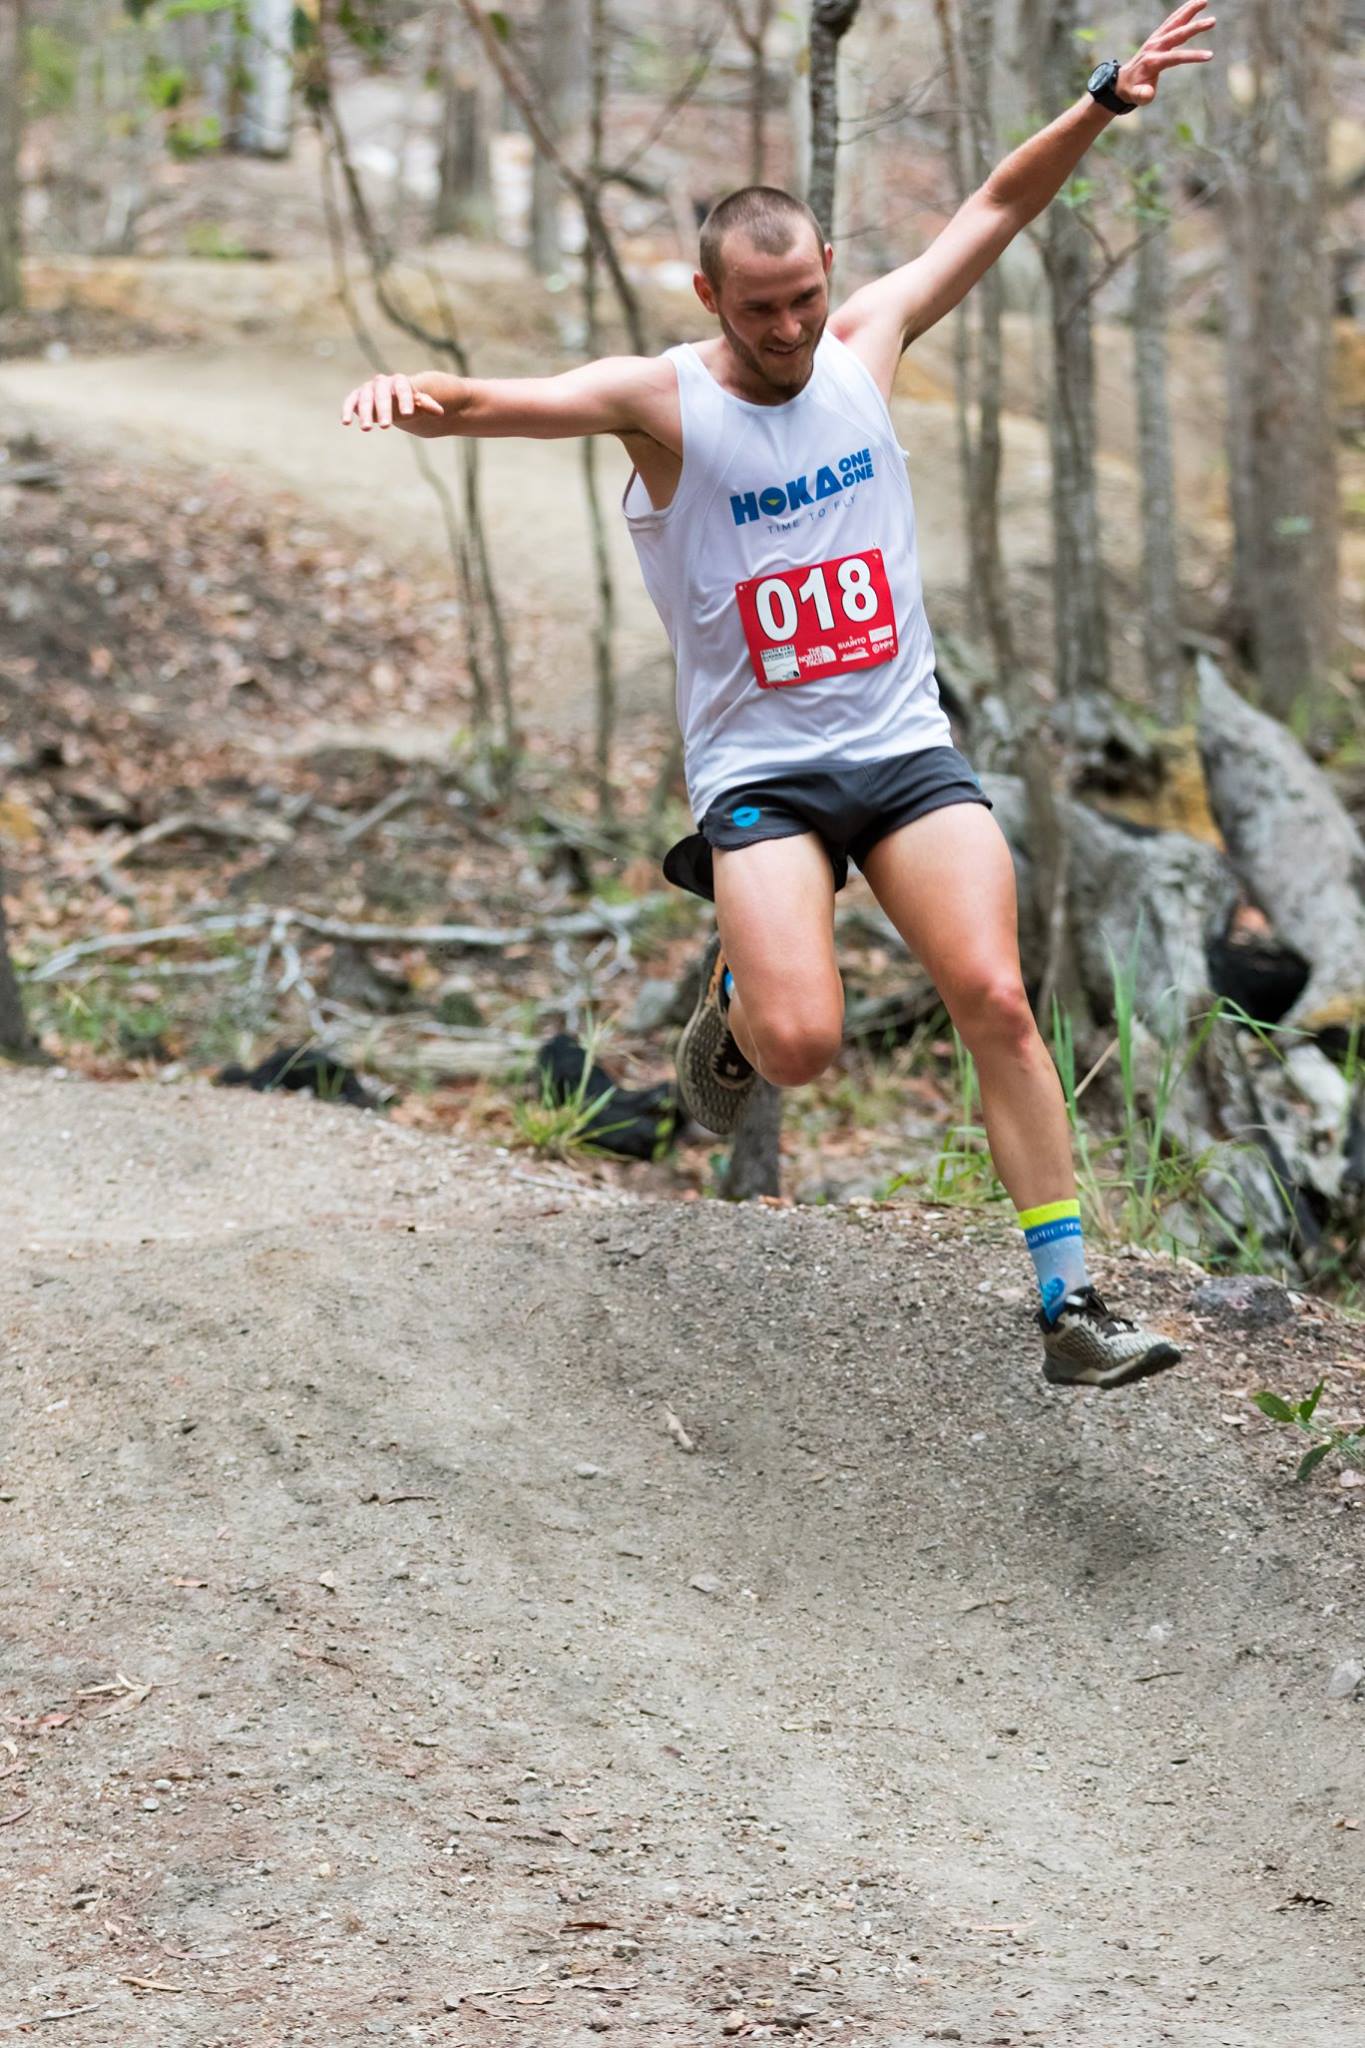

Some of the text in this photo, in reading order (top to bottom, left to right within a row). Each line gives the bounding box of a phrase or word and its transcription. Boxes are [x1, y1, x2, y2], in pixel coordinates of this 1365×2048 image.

[838, 448, 872, 472] ONE
[843, 464, 874, 487] ONE
[730, 465, 843, 526] HOKA
[768, 494, 856, 534] TIME TO FLY
[756, 558, 878, 642] 018
